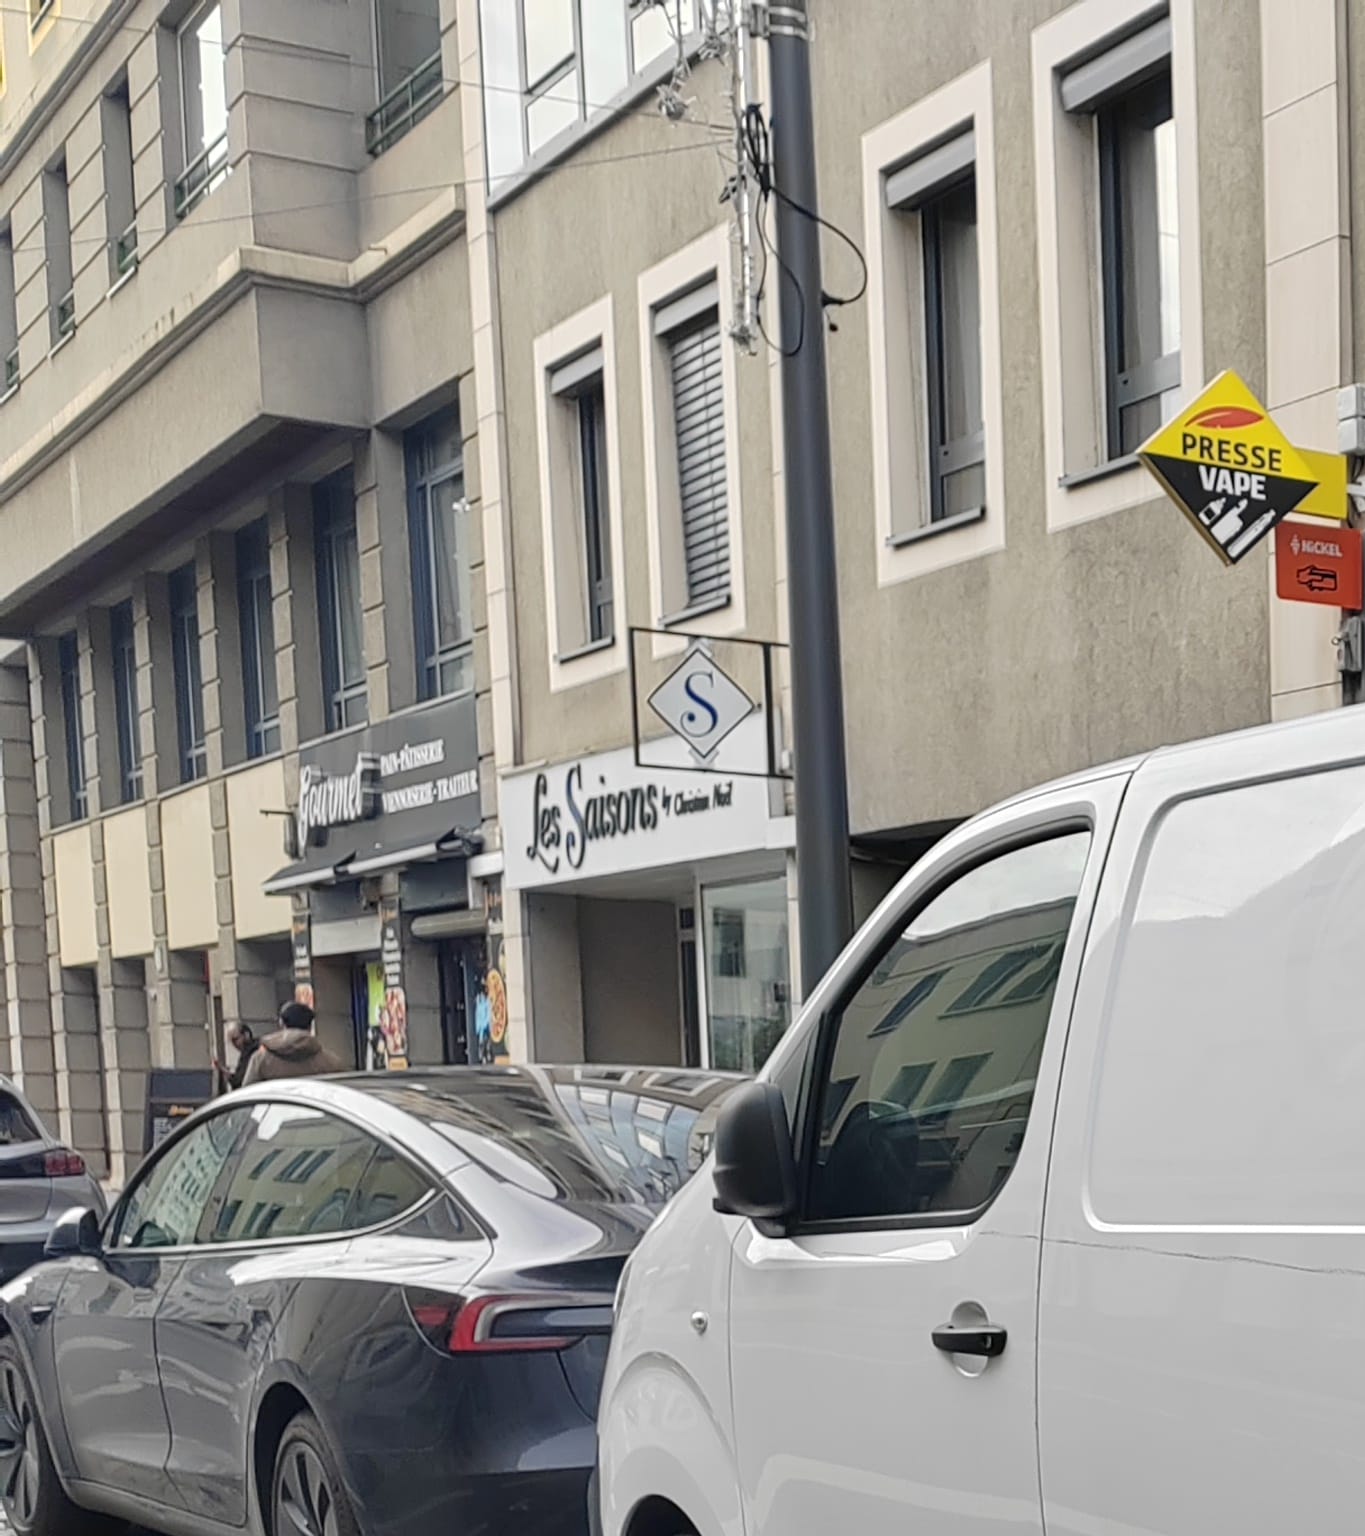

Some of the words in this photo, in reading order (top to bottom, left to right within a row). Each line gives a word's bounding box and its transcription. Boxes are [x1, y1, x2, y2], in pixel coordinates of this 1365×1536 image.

[1181, 432, 1283, 473] PRESSE
[1198, 464, 1267, 501] VAPE
[682, 670, 719, 738] S
[526, 774, 561, 875] Les
[565, 762, 658, 870] Saisons
